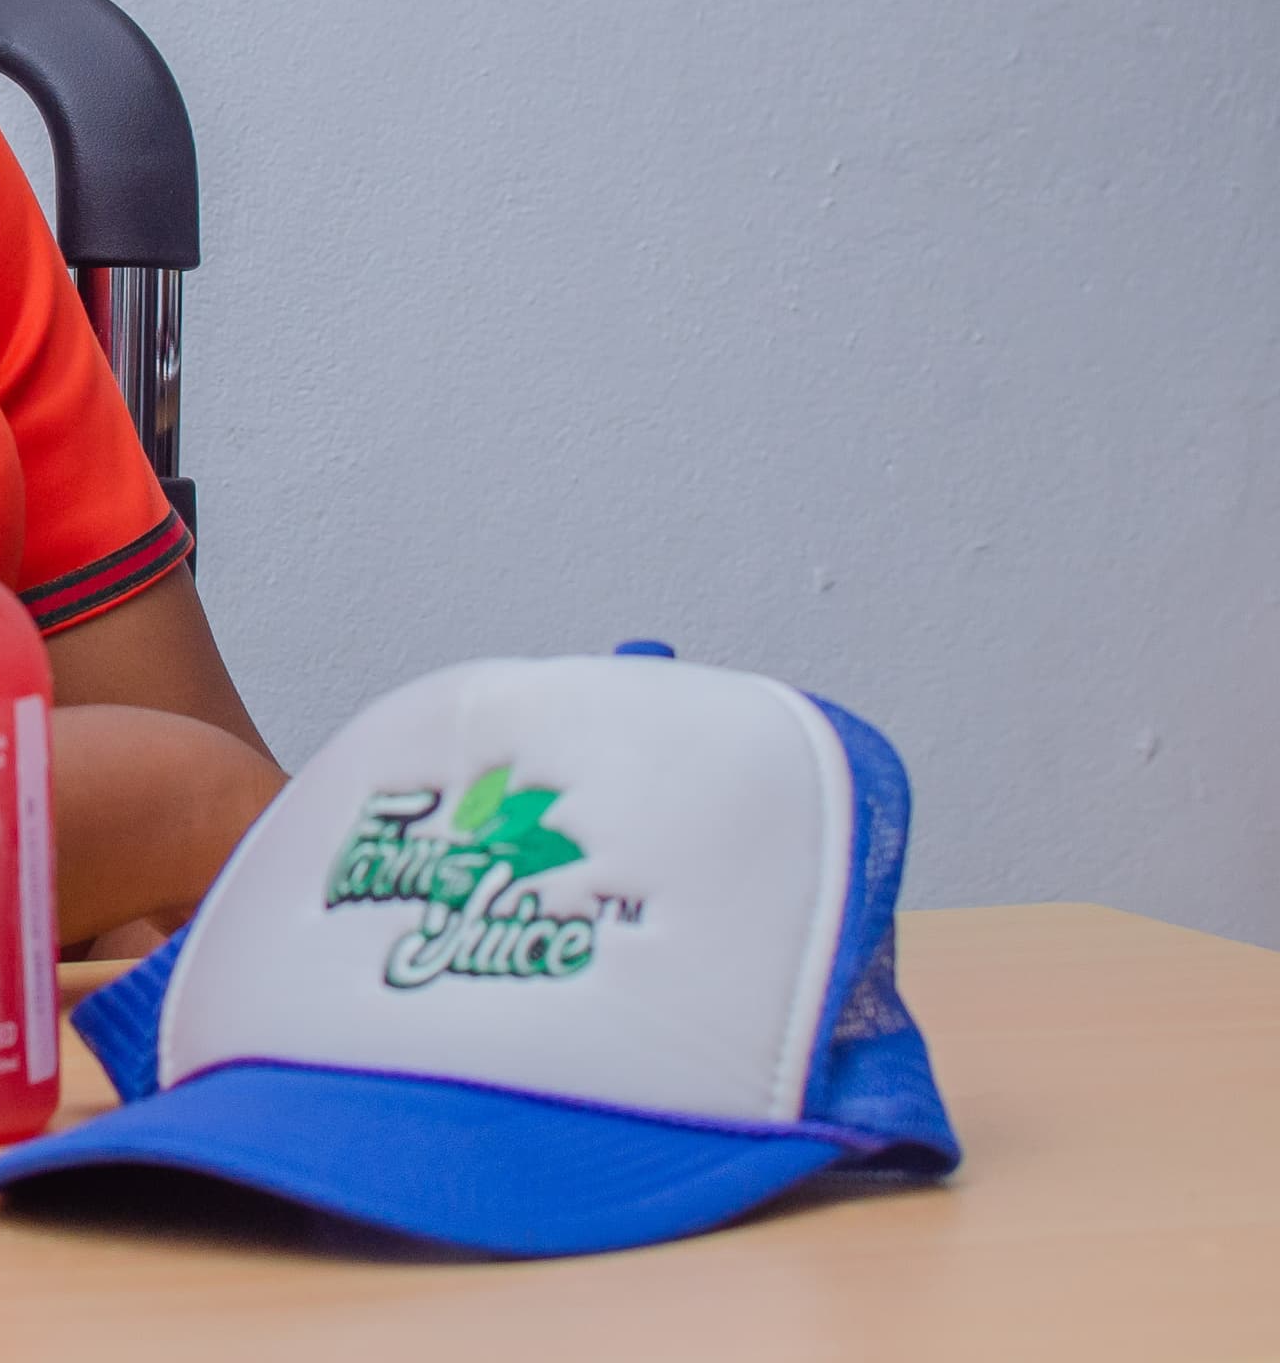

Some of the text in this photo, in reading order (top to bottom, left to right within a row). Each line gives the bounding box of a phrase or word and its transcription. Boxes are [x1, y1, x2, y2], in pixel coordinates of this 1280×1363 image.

[325, 789, 447, 910] Farm
[384, 860, 645, 988] Juice TM
